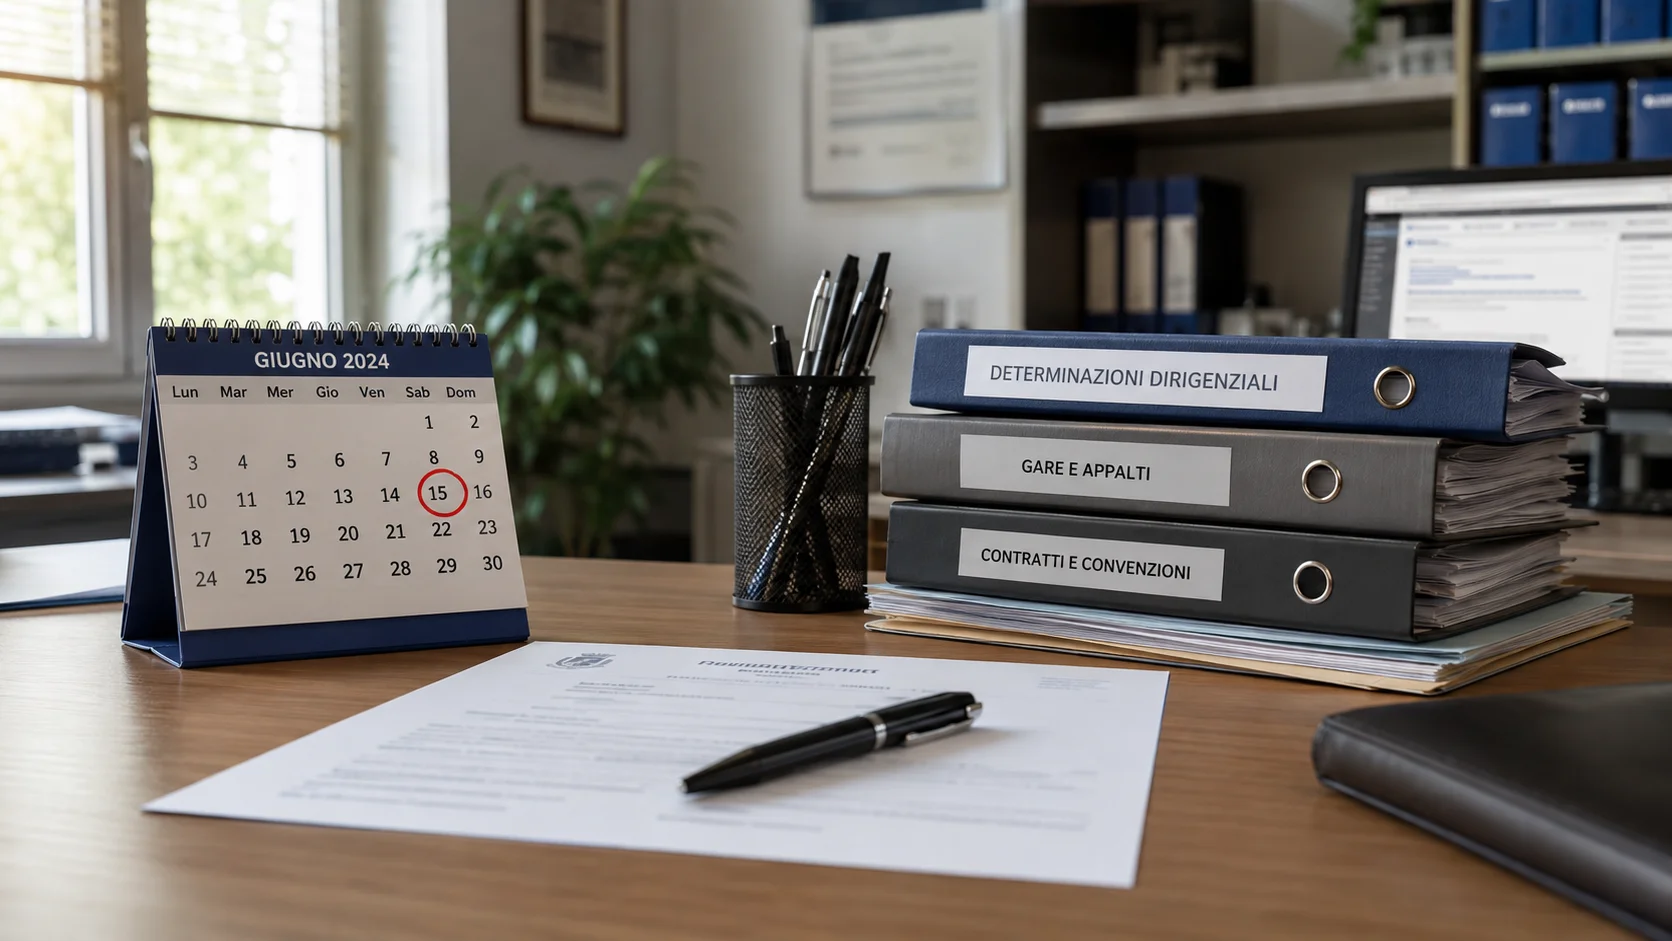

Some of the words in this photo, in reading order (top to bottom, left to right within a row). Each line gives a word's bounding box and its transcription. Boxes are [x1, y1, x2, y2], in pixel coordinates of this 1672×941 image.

[255, 352, 336, 368] GIUGNO
[343, 353, 389, 369] 2024
[991, 365, 1143, 386] DETERMINAZIONI
[1150, 371, 1277, 391] DIRIGENZIALI
[173, 386, 198, 398] Lun
[221, 386, 247, 398] Mar
[267, 386, 293, 397] Mer
[316, 386, 338, 397] Gio
[359, 387, 384, 397] Ven
[406, 386, 430, 398] Sab
[446, 387, 475, 397] Dom
[425, 416, 433, 429] 1
[470, 415, 479, 428] 2
[188, 455, 197, 470] 3
[238, 455, 247, 469] 4
[287, 454, 296, 468] 5
[335, 453, 344, 467] 6
[382, 452, 390, 466] 7
[430, 451, 438, 464] 8
[475, 449, 483, 463] 9
[1022, 460, 1064, 475] GARE
[1069, 462, 1078, 476] E
[1083, 463, 1150, 480] APPALTI
[187, 494, 206, 508] 10
[237, 492, 256, 507] 11
[286, 491, 305, 505] 12
[334, 489, 353, 503] 13
[381, 488, 400, 502] 14
[429, 486, 447, 500] 15
[474, 485, 492, 499] 16
[192, 532, 210, 547] 17
[241, 530, 261, 545] 18
[290, 528, 310, 543] 19
[338, 526, 358, 541] 20
[386, 524, 405, 539] 21
[432, 522, 452, 536] 22
[478, 520, 497, 534] 23
[196, 571, 217, 587] 24
[246, 568, 266, 584] 25
[294, 566, 316, 581] 26
[343, 563, 363, 579] 27
[391, 561, 411, 576] 28
[437, 558, 456, 573] 29
[483, 555, 502, 570] 30
[982, 549, 1064, 568] CONTRATTI
[1069, 556, 1077, 569] E
[1082, 557, 1190, 579] CONVENZIONI
